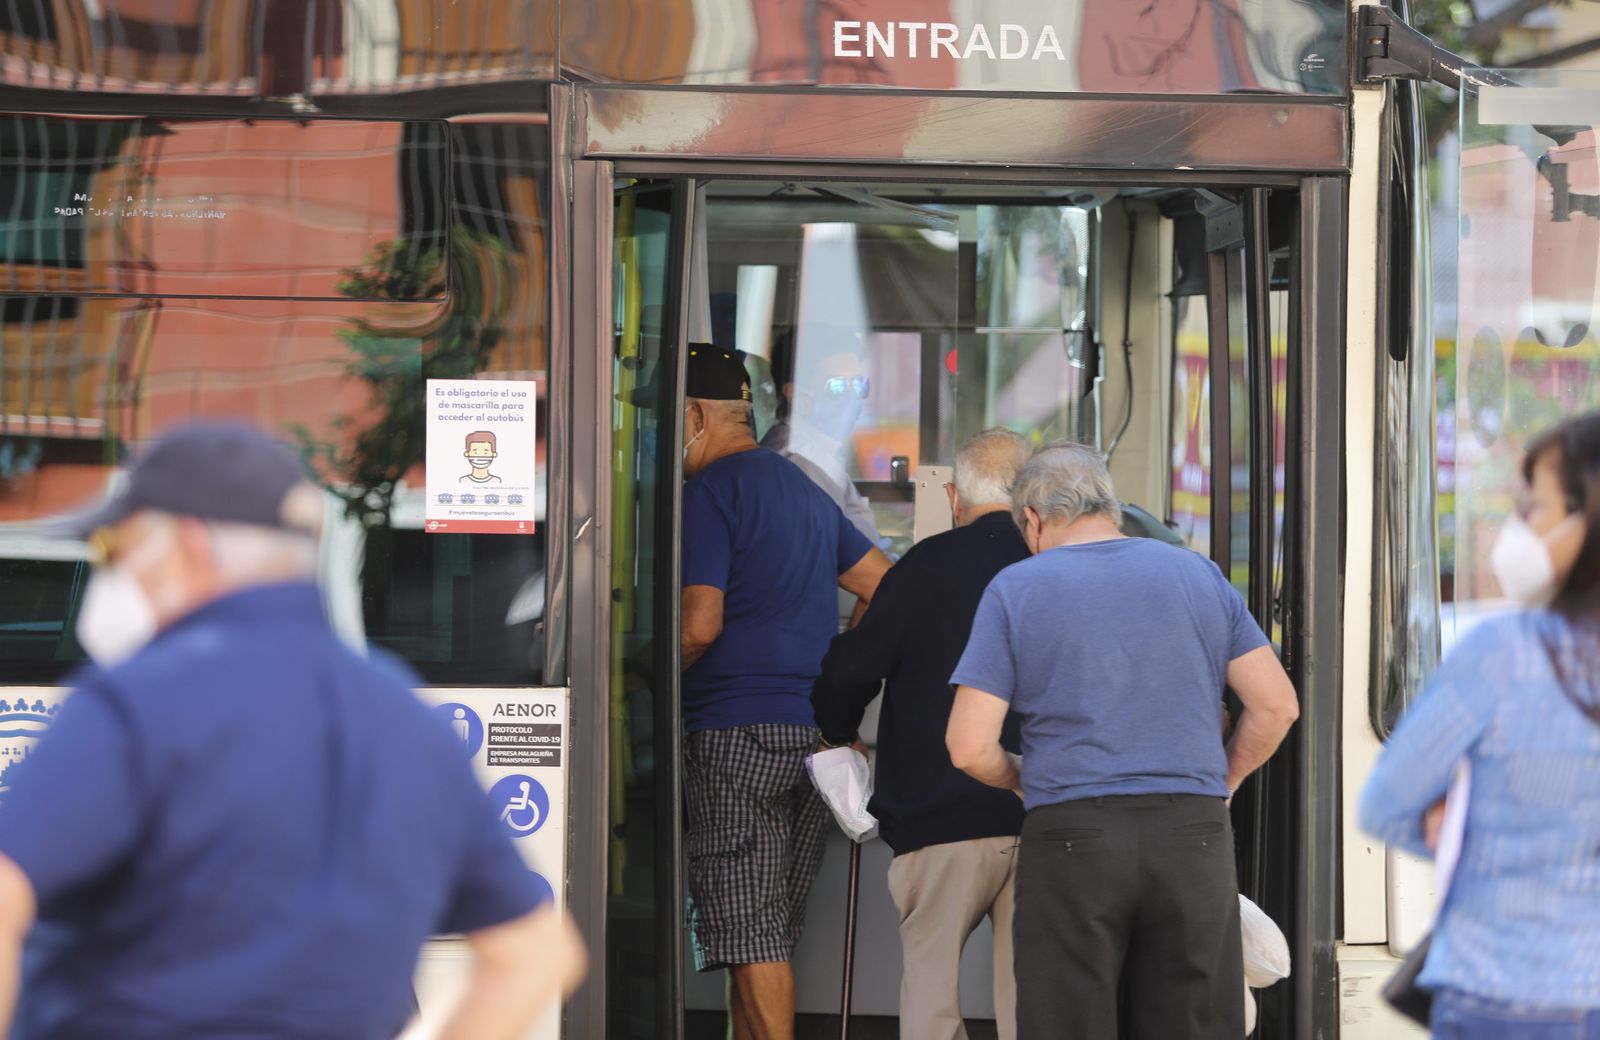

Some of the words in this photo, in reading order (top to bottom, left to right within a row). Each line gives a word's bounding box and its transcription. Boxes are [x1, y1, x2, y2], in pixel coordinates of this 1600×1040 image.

[834, 20, 1066, 60] ENTRADA
[435, 387, 446, 397] Es
[447, 388, 499, 399] obligatorio
[500, 389, 509, 397] el
[438, 400, 450, 409] de
[452, 401, 500, 409] mascarilla
[501, 402, 524, 411] para
[438, 412, 474, 421] acceder
[475, 413, 485, 421] al
[486, 413, 524, 422] autobús
[492, 703, 557, 717] AENOR
[490, 726, 533, 734] PROTOCOLO
[490, 735, 518, 743] FRENTE
